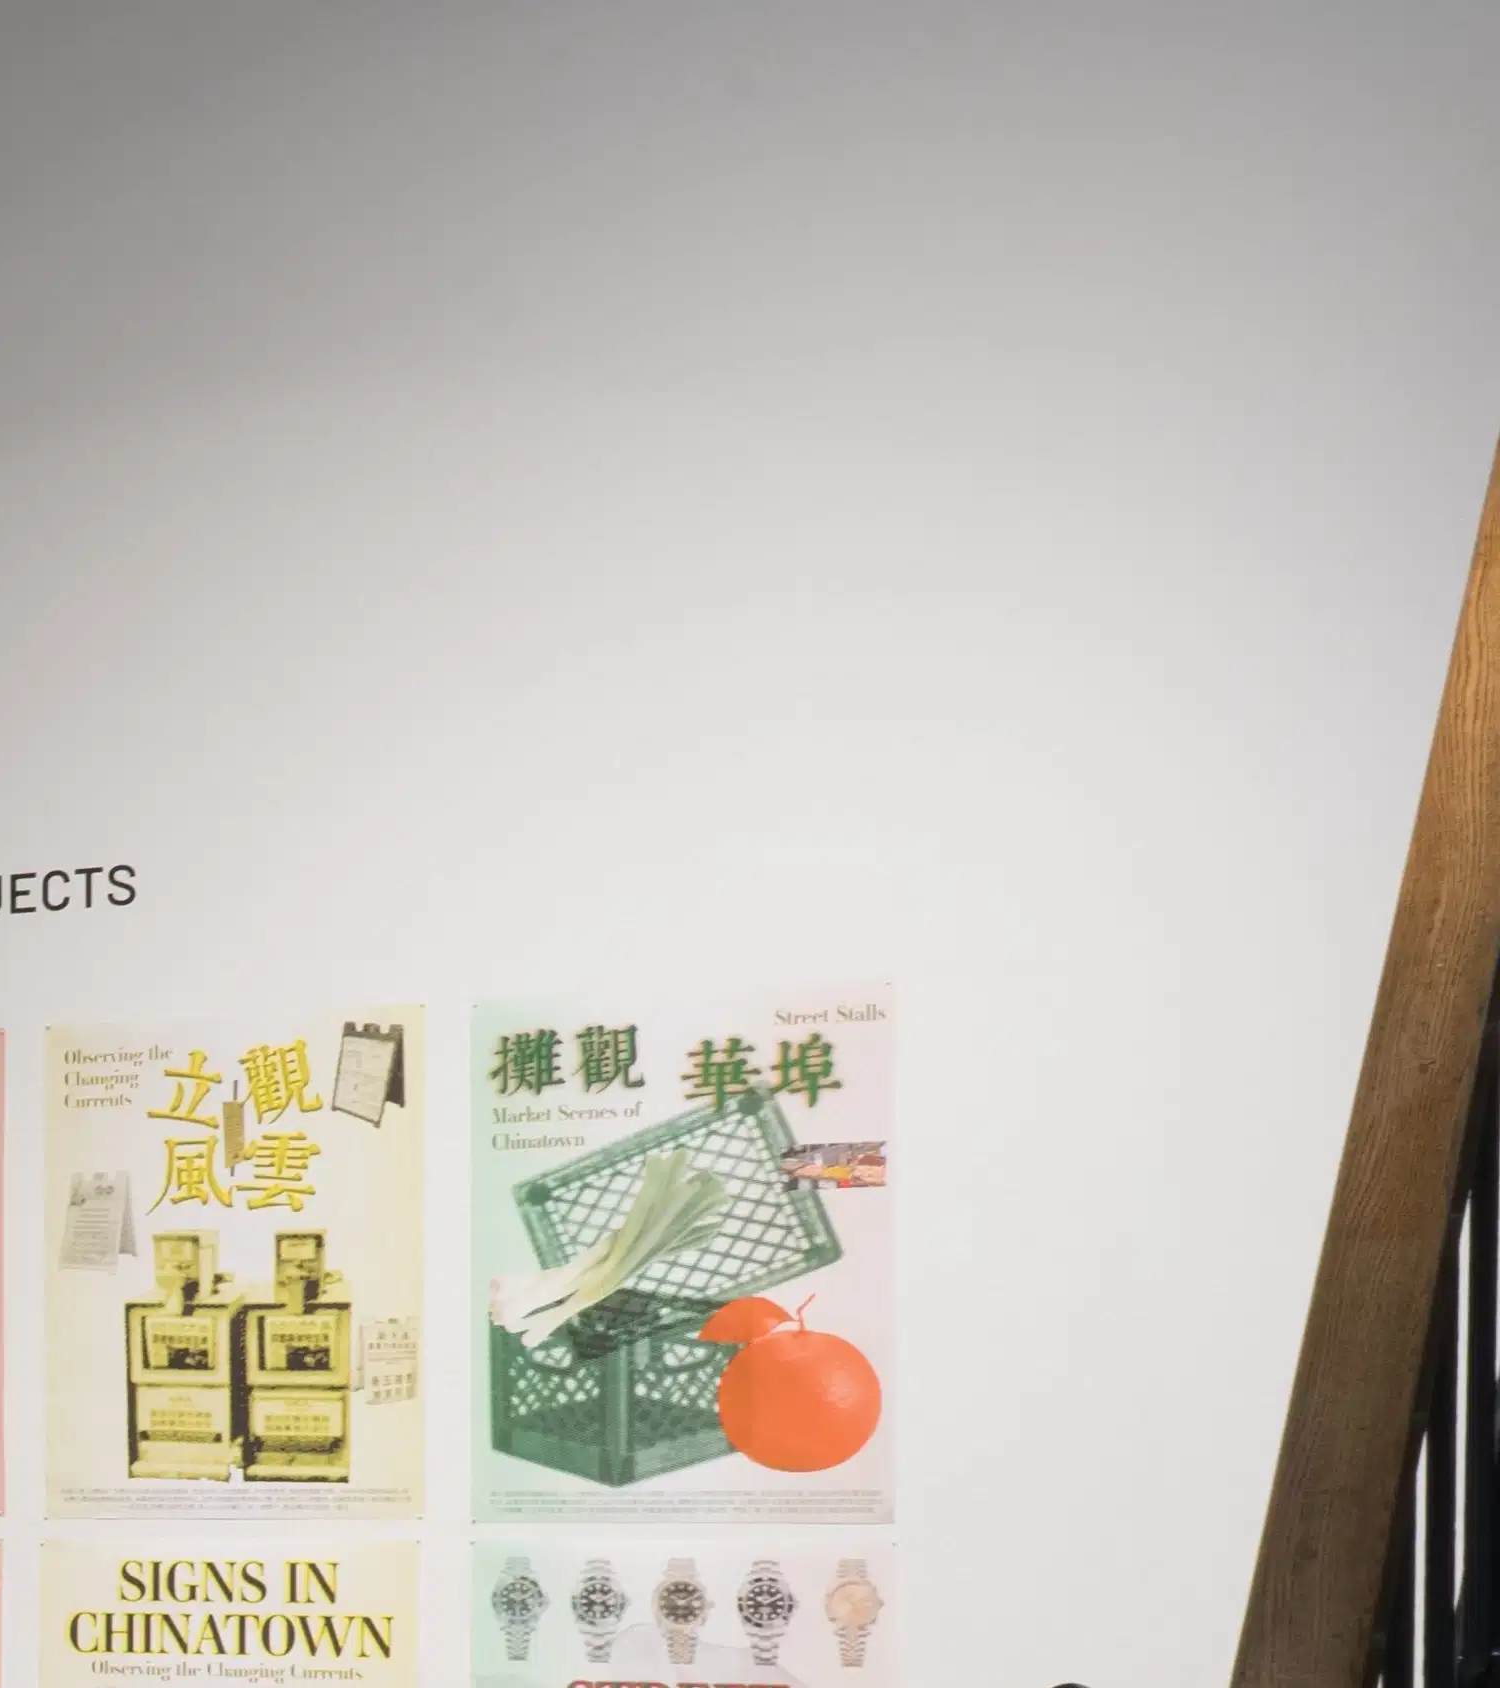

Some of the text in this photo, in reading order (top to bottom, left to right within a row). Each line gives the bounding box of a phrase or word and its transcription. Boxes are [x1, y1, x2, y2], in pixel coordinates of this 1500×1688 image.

[773, 1003, 887, 1026] Street Stalls
[64, 1044, 174, 1067] Observing the
[64, 1068, 140, 1089] Changing
[146, 1038, 324, 1129] 立觀
[64, 1093, 132, 1109] Currents
[491, 1101, 643, 1125] Market Scenes of
[491, 1132, 586, 1151] Chinatown
[144, 1130, 322, 1216] 風雲
[118, 1559, 340, 1605] SIGNS IN
[67, 1610, 395, 1659] CHINATOWN
[91, 1659, 364, 1684] Observing the Changing Currents
